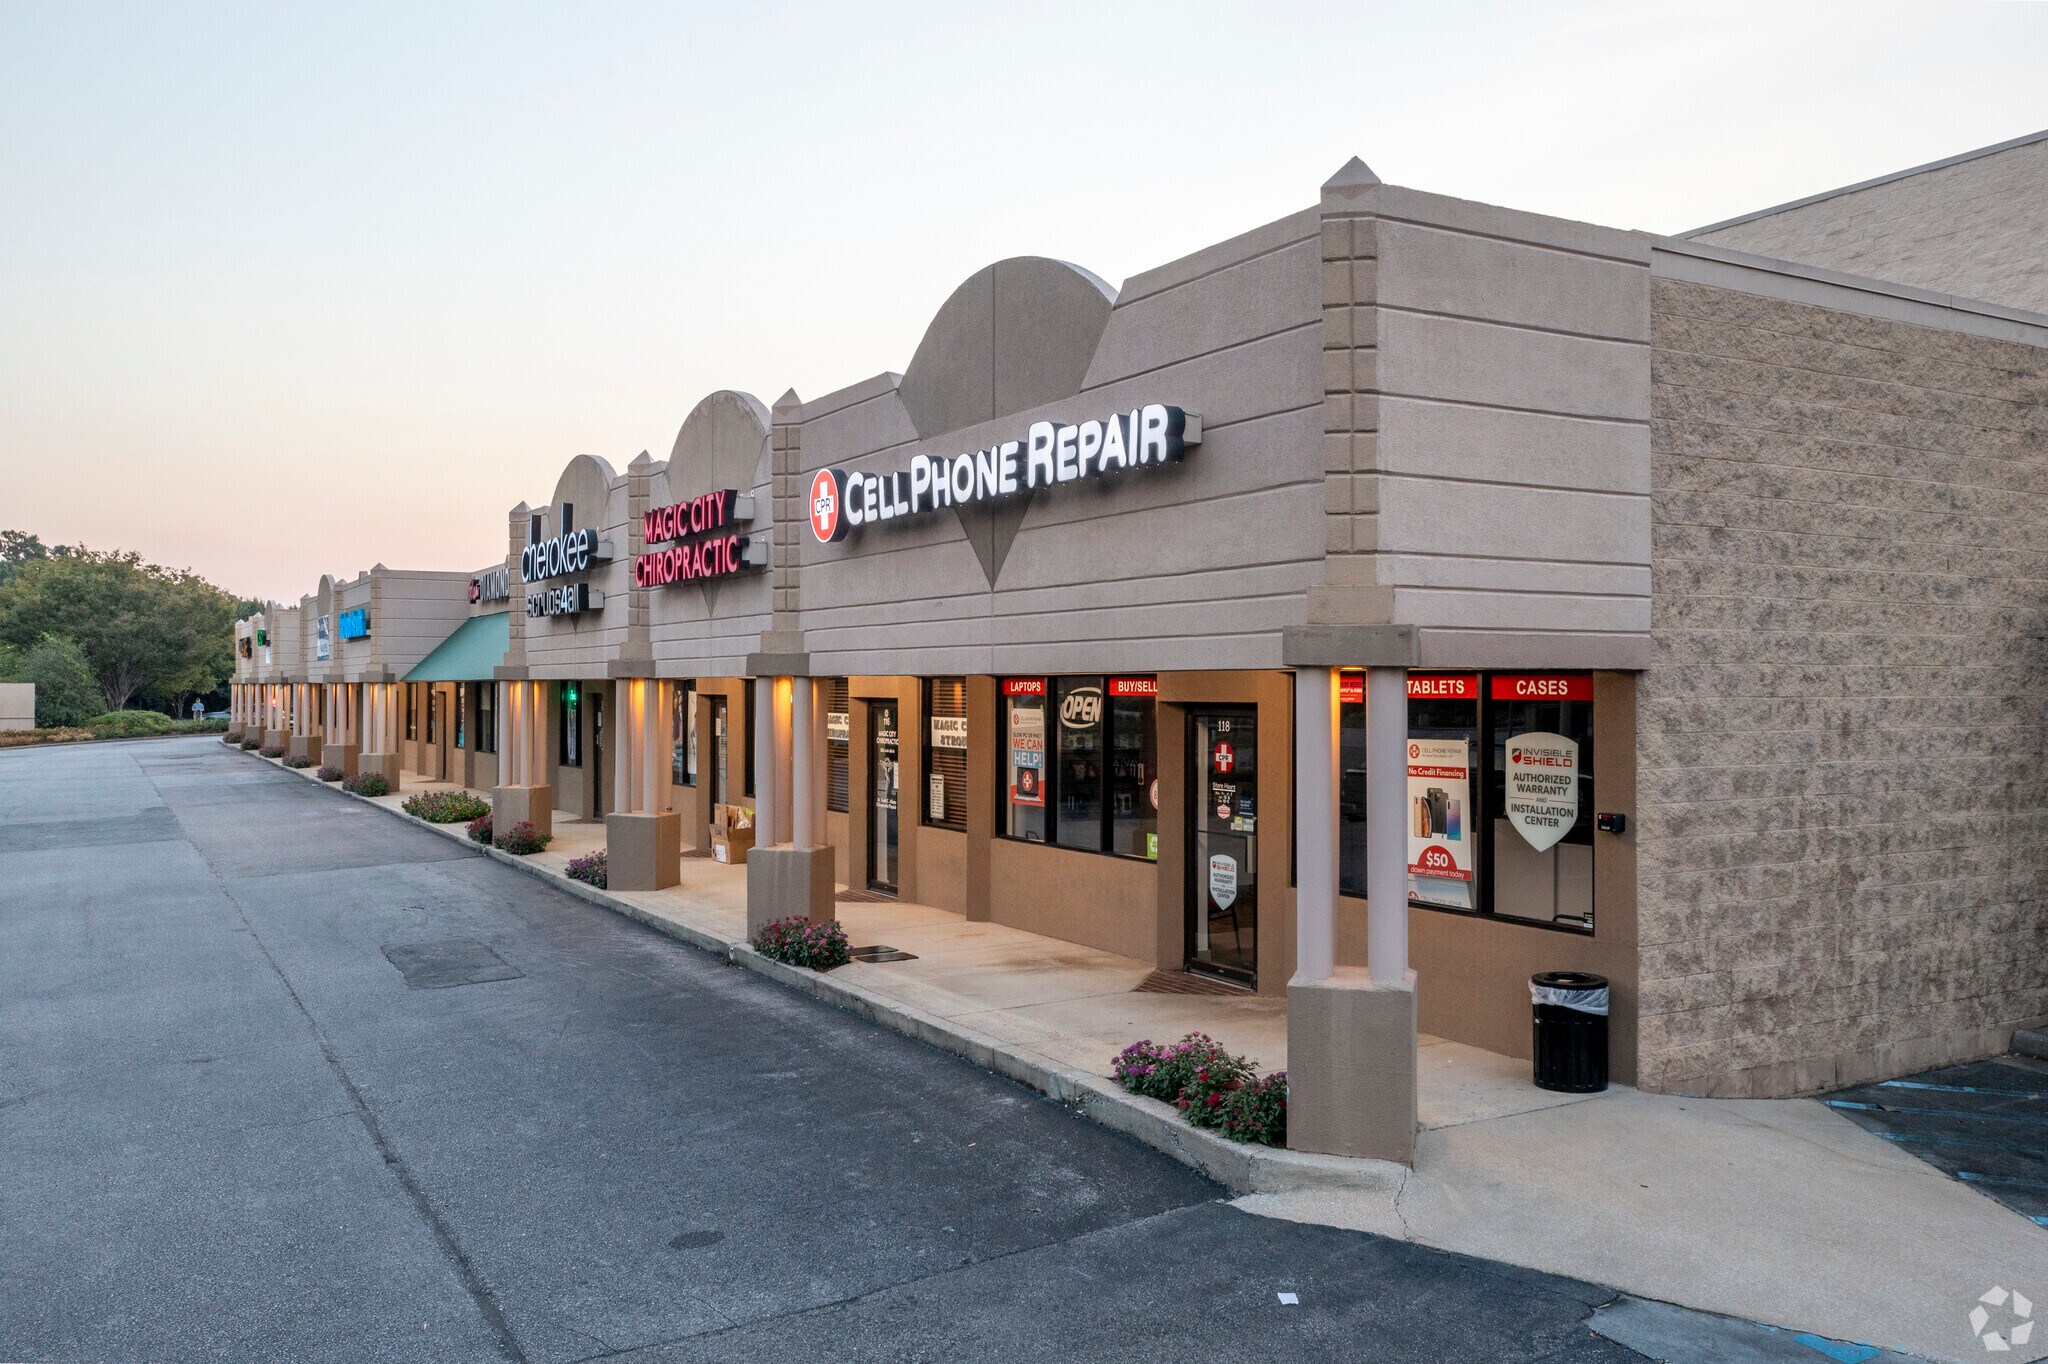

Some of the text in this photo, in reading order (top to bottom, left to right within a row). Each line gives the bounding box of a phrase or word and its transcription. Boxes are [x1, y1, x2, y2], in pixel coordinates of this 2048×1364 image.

[845, 404, 1169, 525] CELL PHONE REPAIR
[815, 498, 831, 514] CPR
[644, 489, 727, 544] MAGIC CITY
[521, 503, 589, 583] cherokee
[635, 535, 738, 588] CHIROPRACTIC
[1010, 681, 1041, 692] LAPTOPS
[1118, 681, 1158, 692] BUY/SELL
[1407, 680, 1465, 694] TABLETS
[1516, 680, 1568, 695] CASES
[1063, 695, 1101, 722] OPEN
[933, 719, 958, 731] MAGIC
[1218, 720, 1230, 732] 118
[1013, 738, 1043, 750] WE CAN
[1014, 751, 1042, 767] HELP!
[1523, 748, 1573, 758] INVISIBLE
[1523, 756, 1572, 767] SHIELD
[1408, 767, 1464, 779] No Credit Financing
[1513, 772, 1571, 785] AUTHORIZED
[1516, 783, 1568, 796] WARRANTY
[1511, 803, 1574, 818] INSTALLATION
[1524, 815, 1560, 828] CENTER
[1426, 850, 1449, 868] $50
[1410, 866, 1465, 879] down payment today
